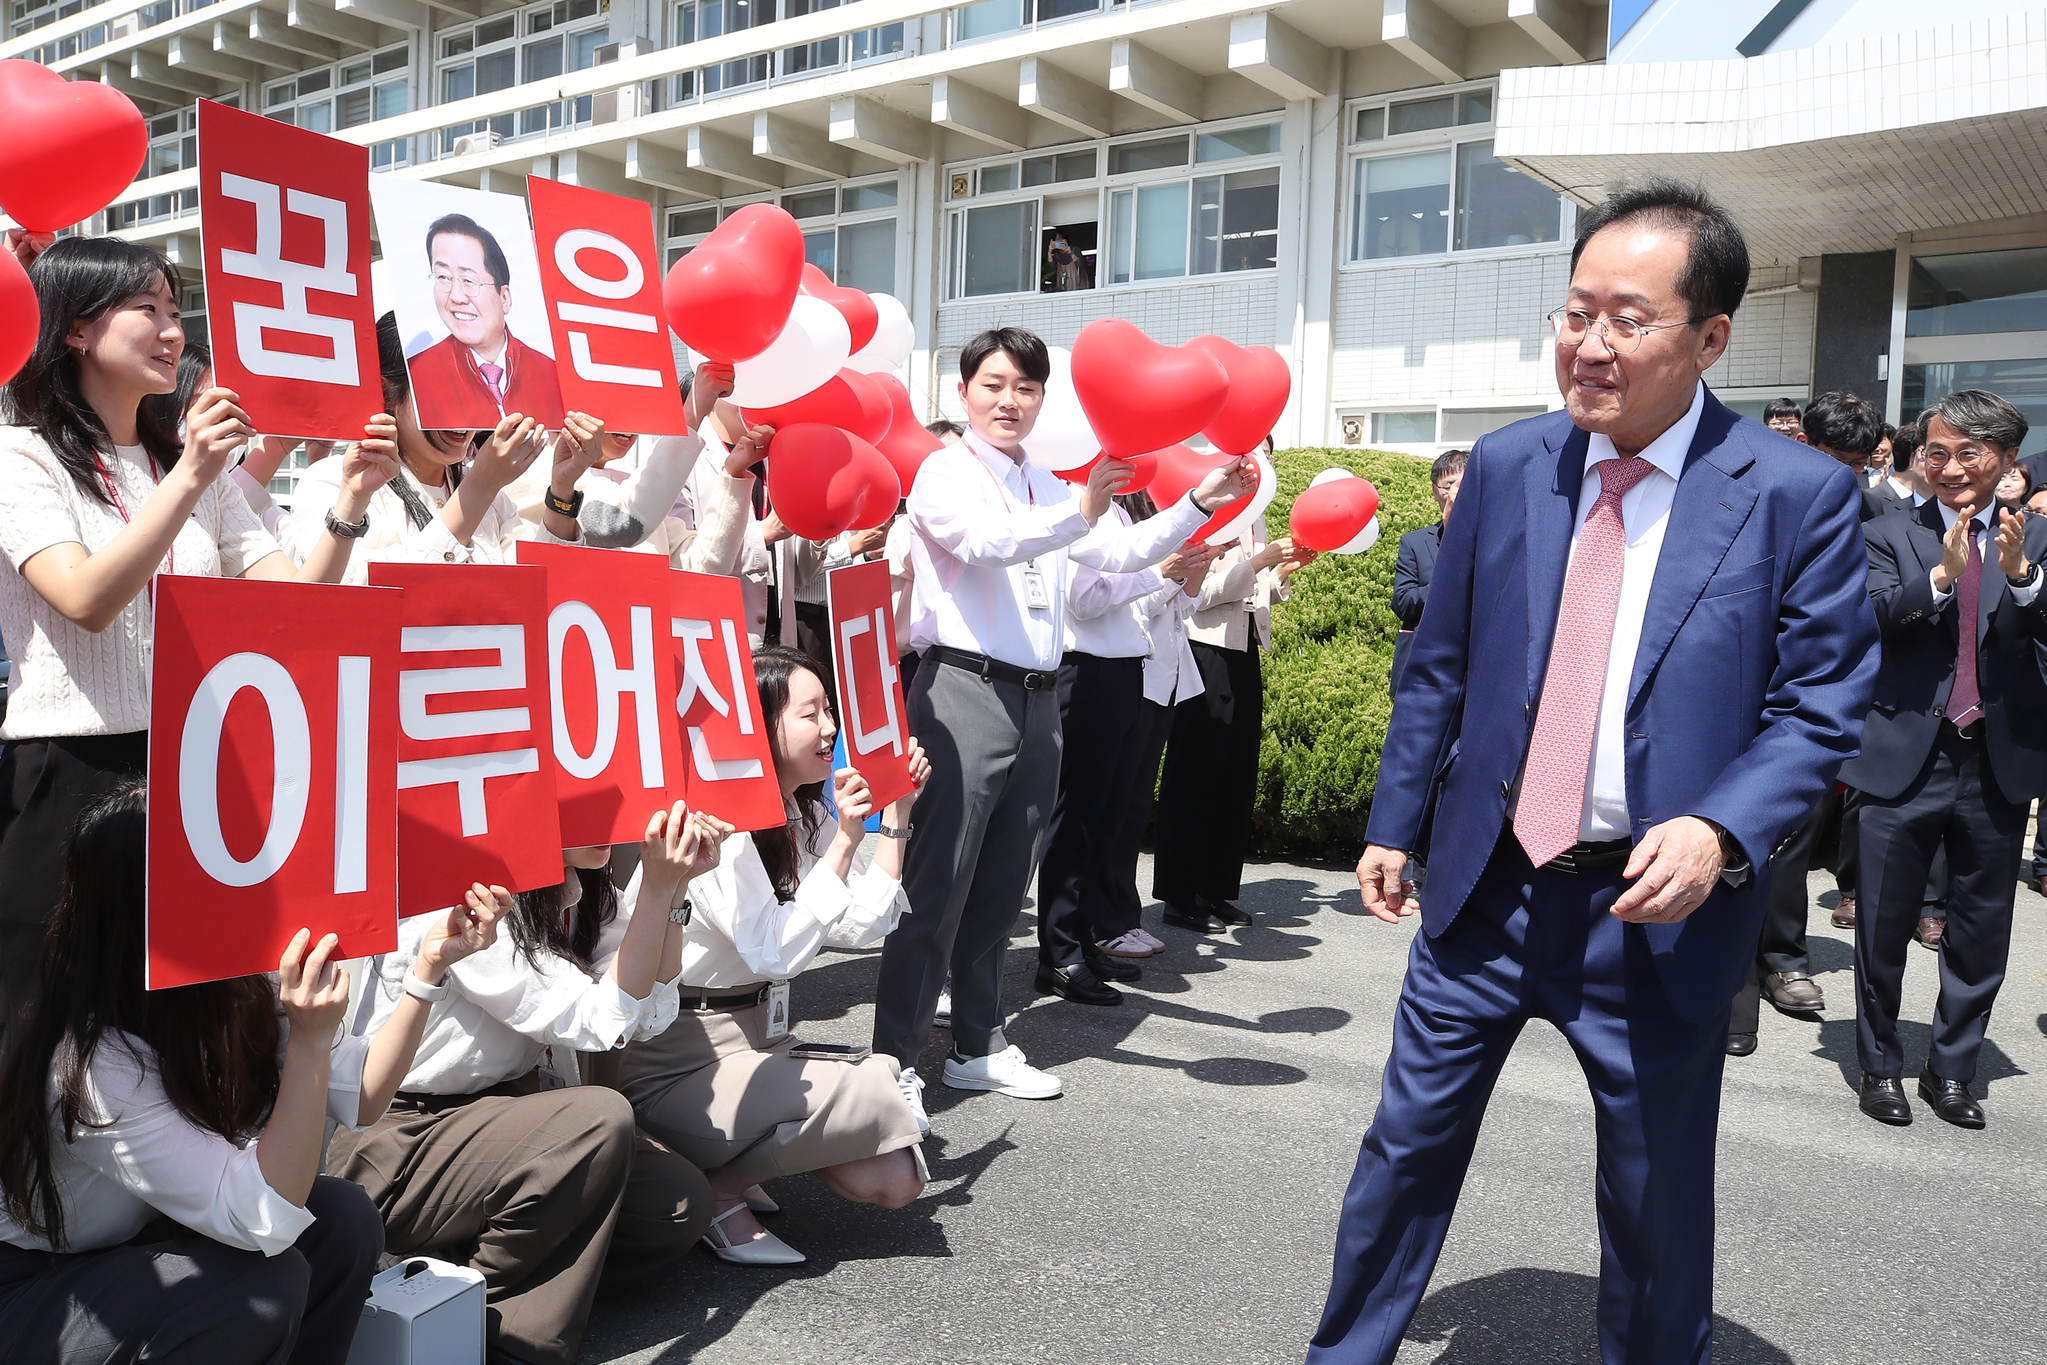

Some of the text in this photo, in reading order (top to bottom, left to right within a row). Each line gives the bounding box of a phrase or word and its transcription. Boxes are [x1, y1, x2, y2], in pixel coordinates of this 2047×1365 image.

[221, 172, 663, 388] 꿈 은
[840, 607, 903, 757] 다
